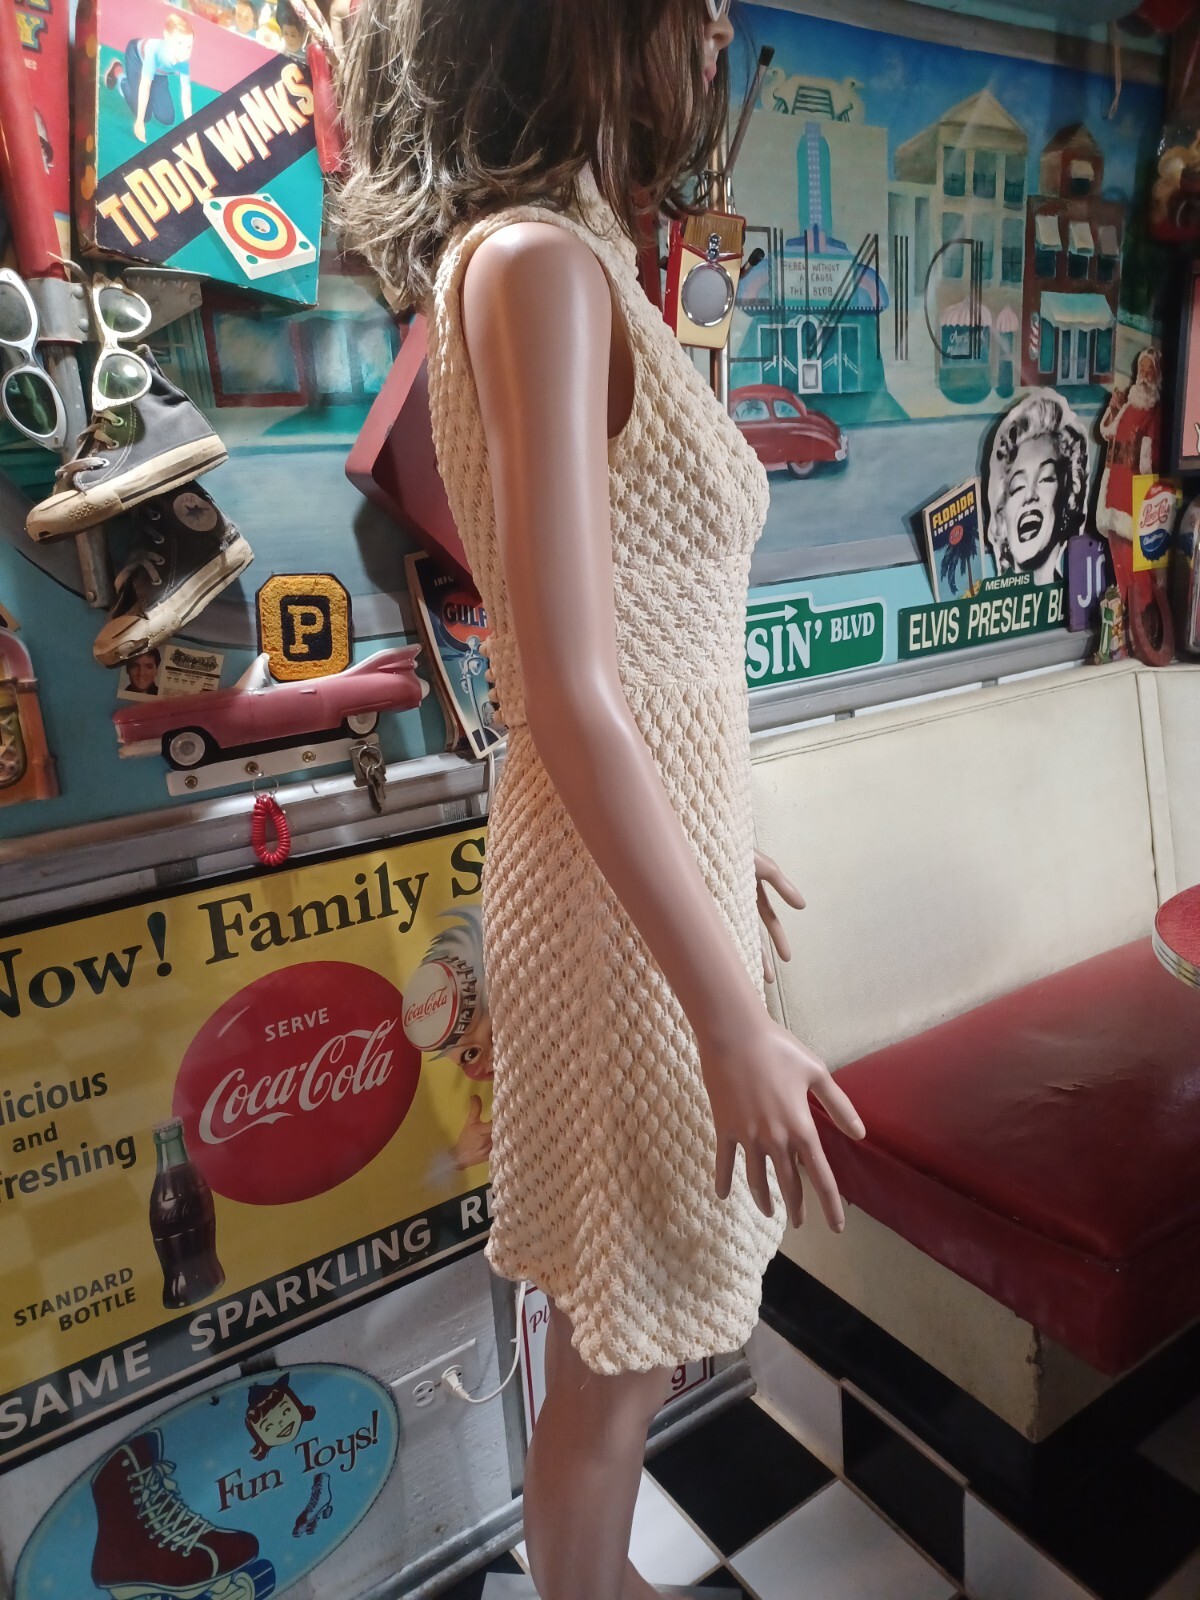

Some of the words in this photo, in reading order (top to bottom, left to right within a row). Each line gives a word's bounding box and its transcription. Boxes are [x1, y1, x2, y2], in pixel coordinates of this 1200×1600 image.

[204, 63, 314, 172] WINKS
[810, 273, 833, 282] CAUSE
[812, 263, 840, 272] WITHOUT
[813, 287, 833, 296] BLOB
[932, 491, 974, 529] FLORIDA
[984, 574, 1030, 592] MEMPHIS
[287, 605, 324, 654] P
[830, 611, 876, 643] BLVD
[909, 607, 960, 651] ELVIS
[967, 591, 1043, 641] PRESLEY
[198, 861, 430, 965] Family
[264, 1007, 330, 1042] SERVE
[198, 1016, 398, 1144] Coca-Cola
[13, 1121, 58, 1153] and
[13, 1267, 134, 1327] STANDARD
[58, 1287, 136, 1331] BOTTLE
[0, 1340, 152, 1440] SAME
[188, 1218, 431, 1351] SPARKLING
[214, 1468, 285, 1513] Fun
[294, 1410, 379, 1473] Toys!
